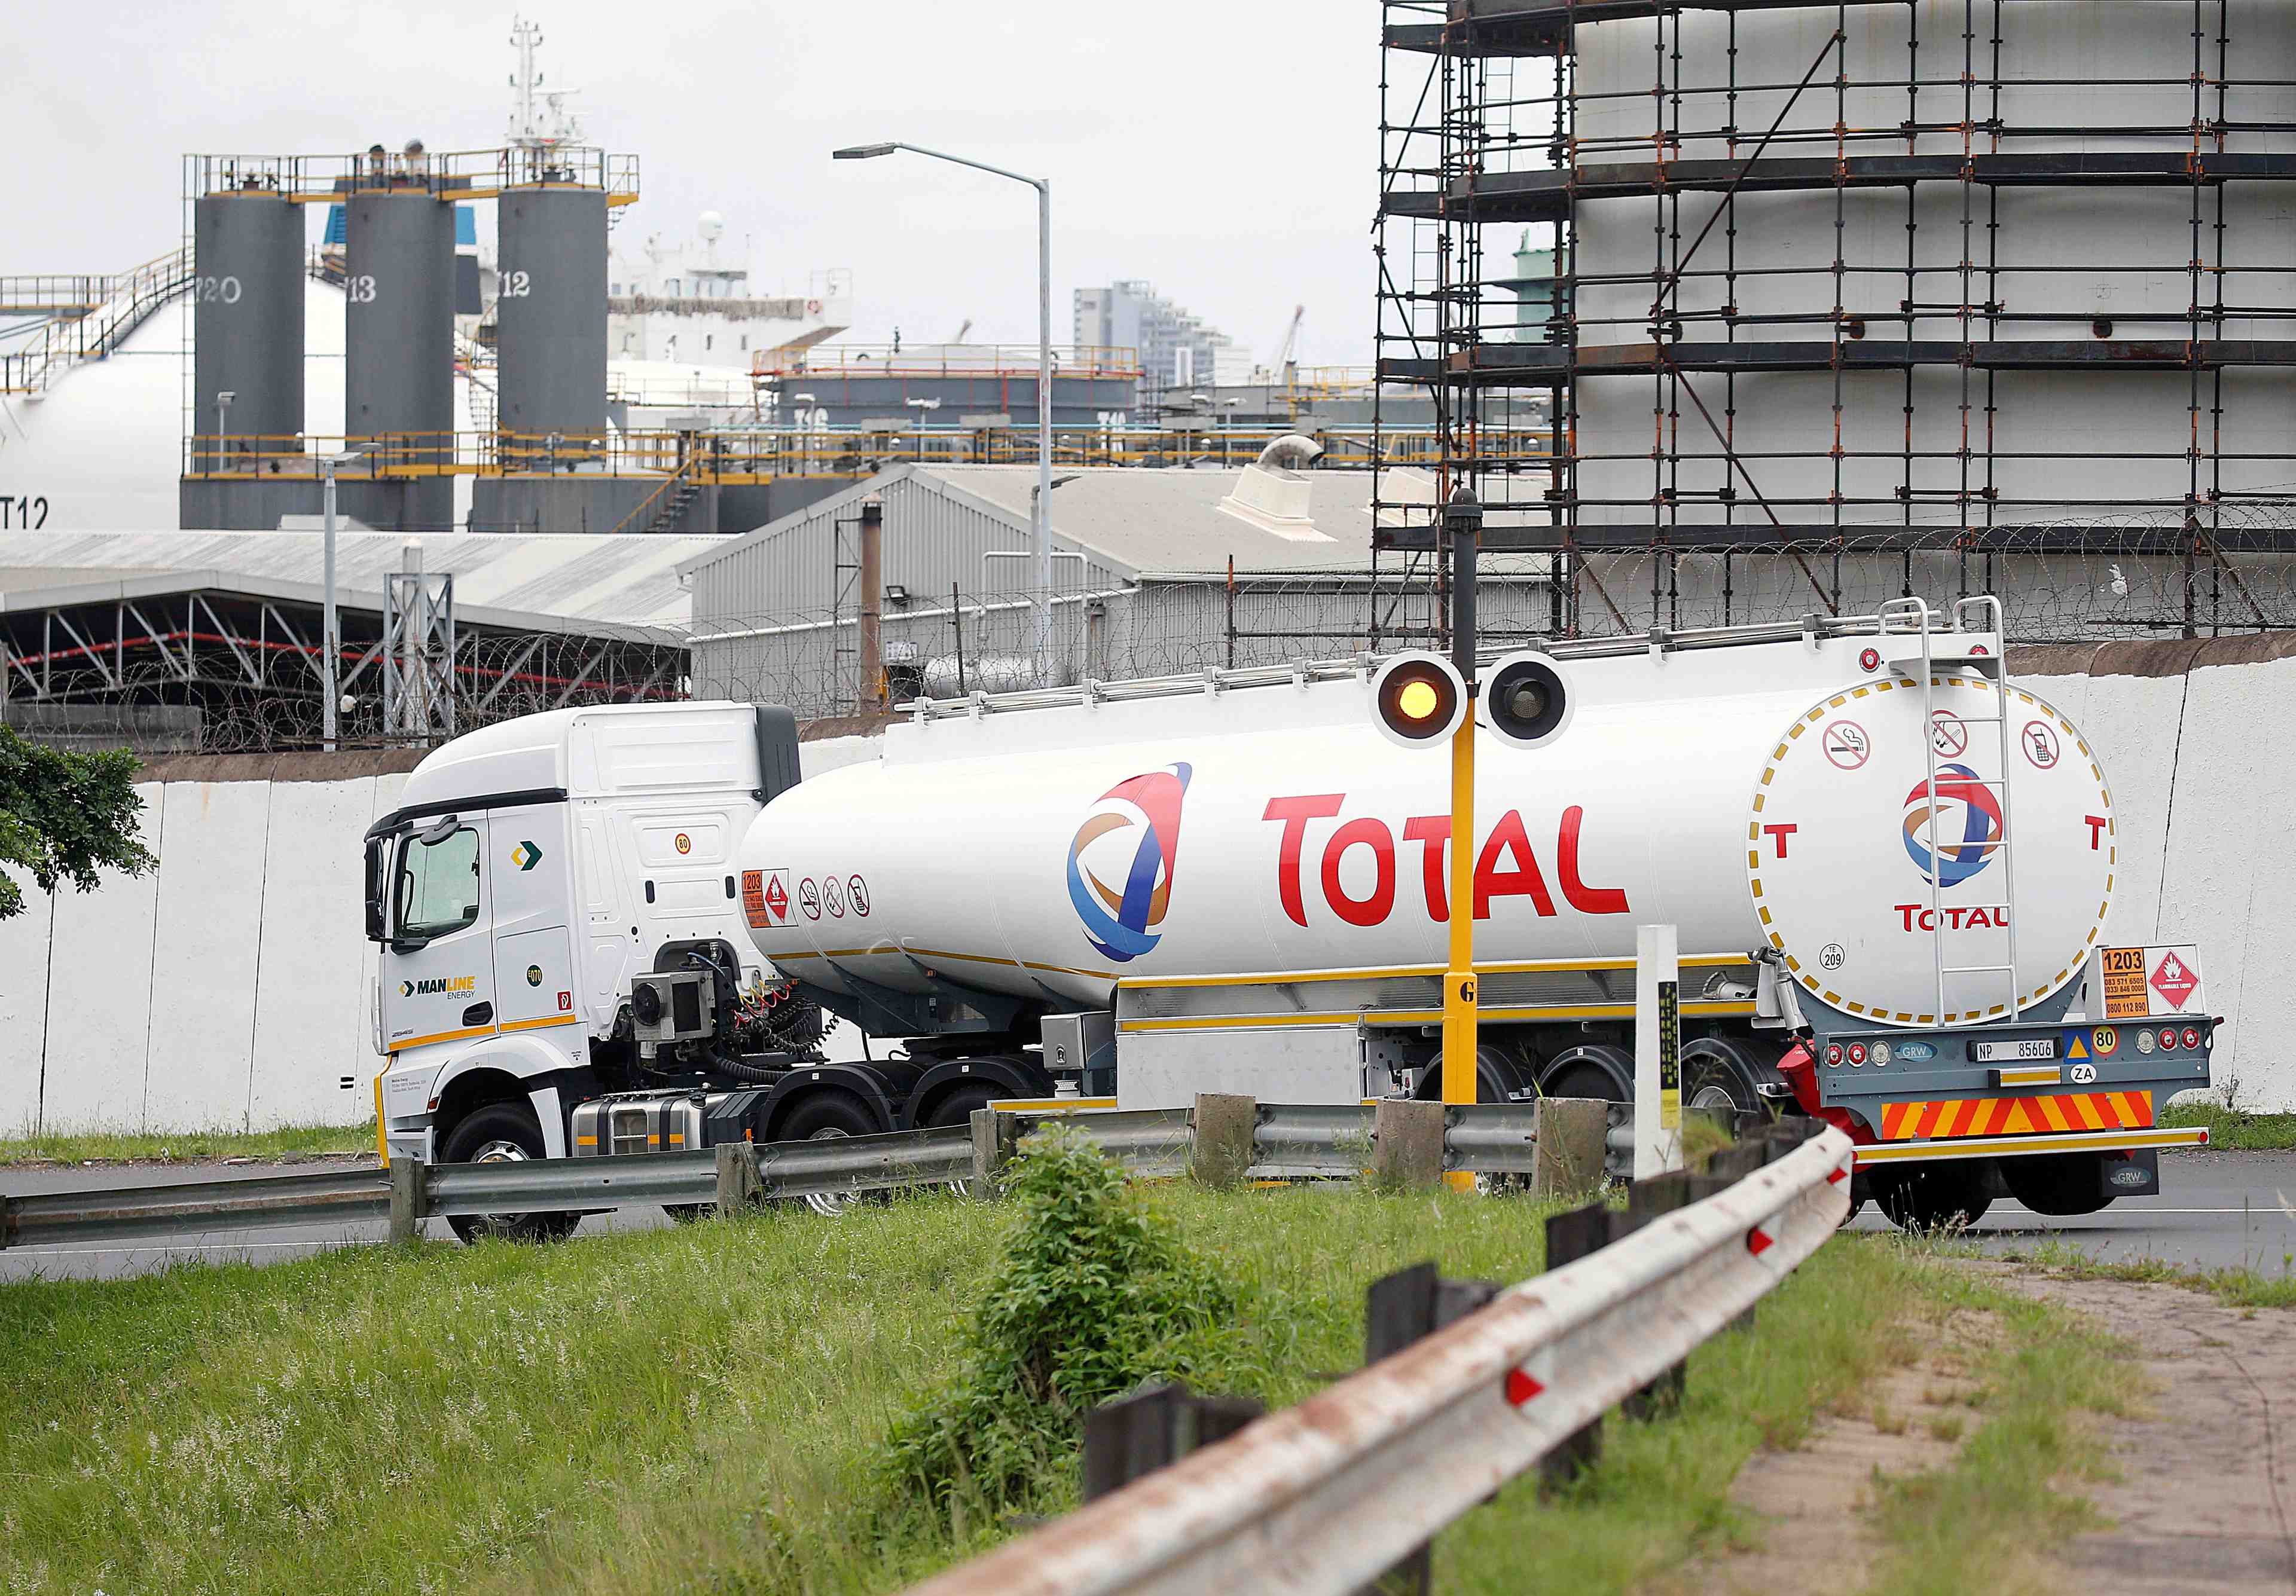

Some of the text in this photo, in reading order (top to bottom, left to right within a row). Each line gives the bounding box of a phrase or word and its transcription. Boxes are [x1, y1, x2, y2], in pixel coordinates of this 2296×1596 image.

[344, 275, 377, 303] 13
[497, 271, 530, 297] 12
[0, 496, 48, 530] T12
[1764, 824, 1797, 858] T
[2084, 815, 2106, 851] T
[679, 839, 688, 849] 80
[1261, 793, 1631, 928] TOTAL
[743, 874, 761, 890] 1203
[1894, 904, 2009, 932] TOTAL
[1824, 953, 1841, 966] 209
[2104, 951, 2142, 970] 1203
[417, 976, 475, 995] MANLINE
[447, 990, 476, 999] ENERGY
[2106, 1002, 2146, 1013] 0800 112 890
[2096, 1031, 2114, 1047] 80
[1903, 1047, 1927, 1057] GRW
[1979, 1042, 2051, 1059] NP 85606
[2074, 1068, 2093, 1080] ZA
[2118, 1172, 2141, 1182] GRW
